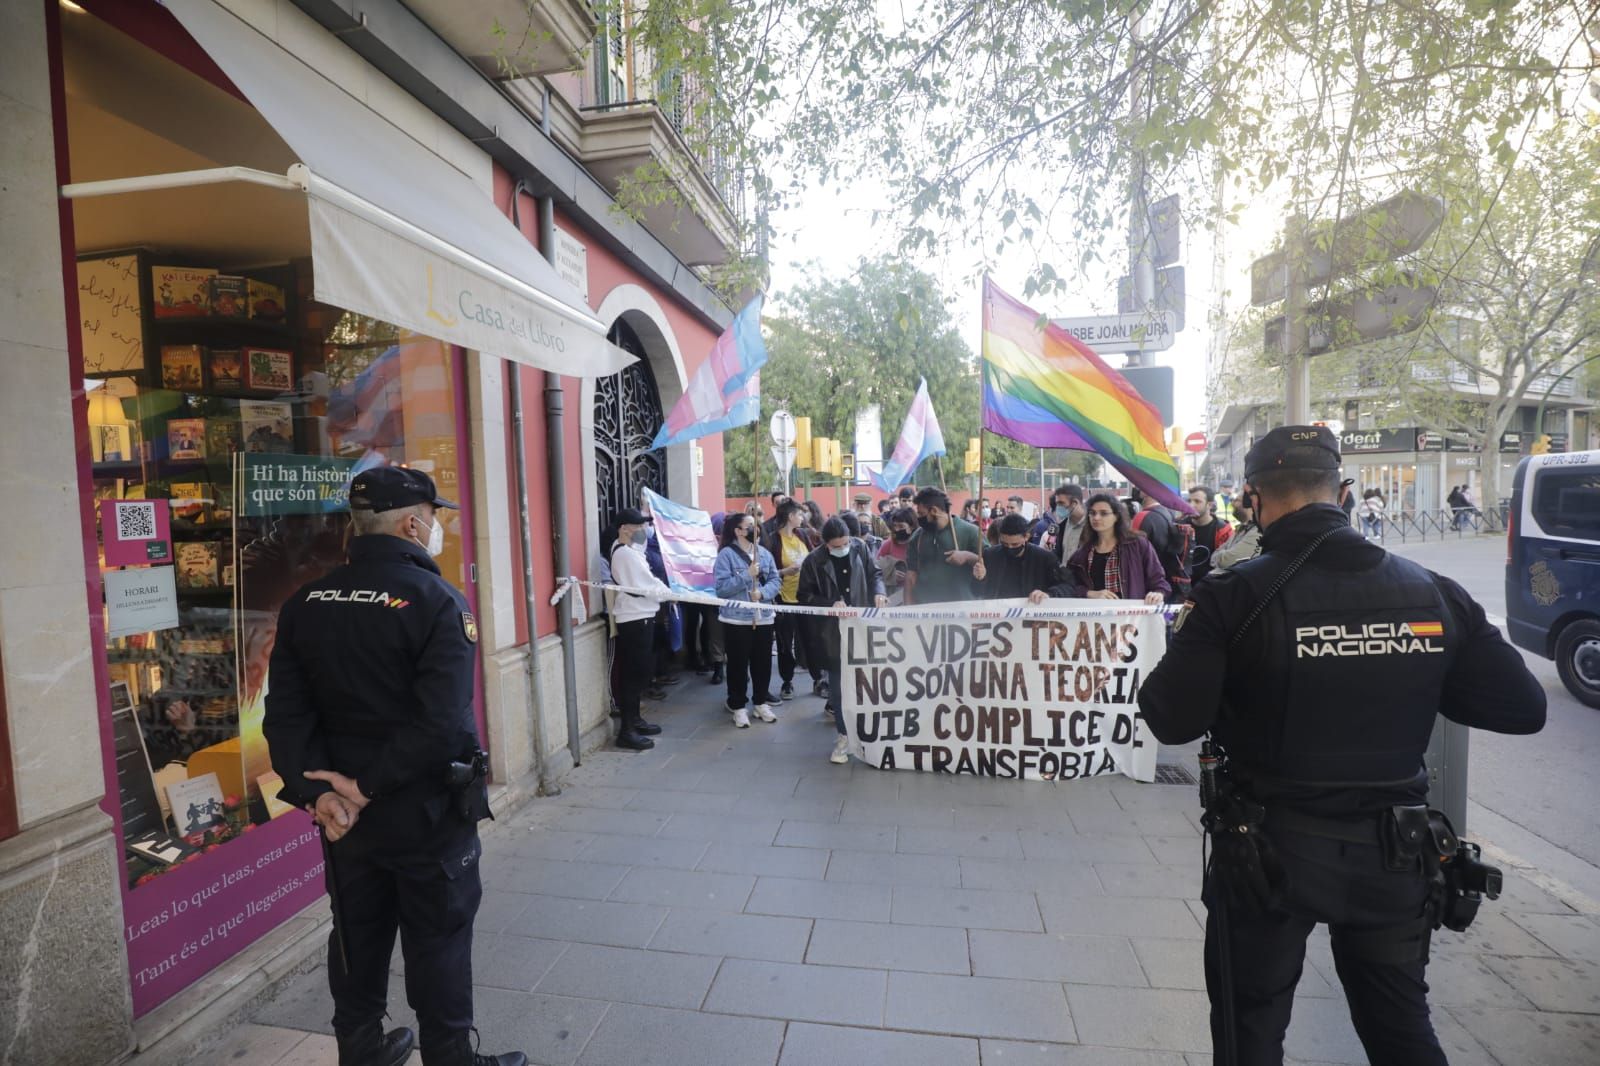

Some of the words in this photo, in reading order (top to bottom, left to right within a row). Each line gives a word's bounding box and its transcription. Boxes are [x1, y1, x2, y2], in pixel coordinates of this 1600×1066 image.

[458, 290, 505, 330] Casa
[509, 318, 529, 339] del
[529, 319, 566, 353] Libro
[1097, 324, 1127, 340] JOAN
[1291, 431, 1319, 442] CNP
[253, 464, 273, 481] Hi
[278, 464, 298, 482] ha
[252, 487, 284, 507] que
[288, 483, 316, 501] són
[124, 585, 159, 598] HORARI
[305, 589, 390, 603] POLICIA
[847, 625, 907, 665] LES
[916, 621, 1015, 663] VIDES
[1022, 619, 1139, 663] TRANS
[1296, 622, 1415, 642] POLICIA
[1297, 638, 1444, 658] NACIONAL
[855, 665, 899, 705] NO
[905, 662, 964, 702] SÓN
[970, 660, 1029, 701] UNA
[856, 707, 920, 743] UIB
[933, 697, 1105, 748] CÒMPLICE
[904, 744, 1116, 781] TRANSFÒBIA
[127, 907, 170, 943] Leas
[171, 898, 189, 917] lo
[191, 880, 221, 909] que
[222, 864, 255, 890] leas,
[256, 847, 283, 869] esta
[284, 839, 298, 854] es
[299, 832, 313, 846] tu
[135, 952, 178, 988] Tant
[180, 939, 198, 960] és
[200, 927, 215, 947] el
[217, 910, 246, 939] que
[246, 877, 304, 919] llegeixis,
